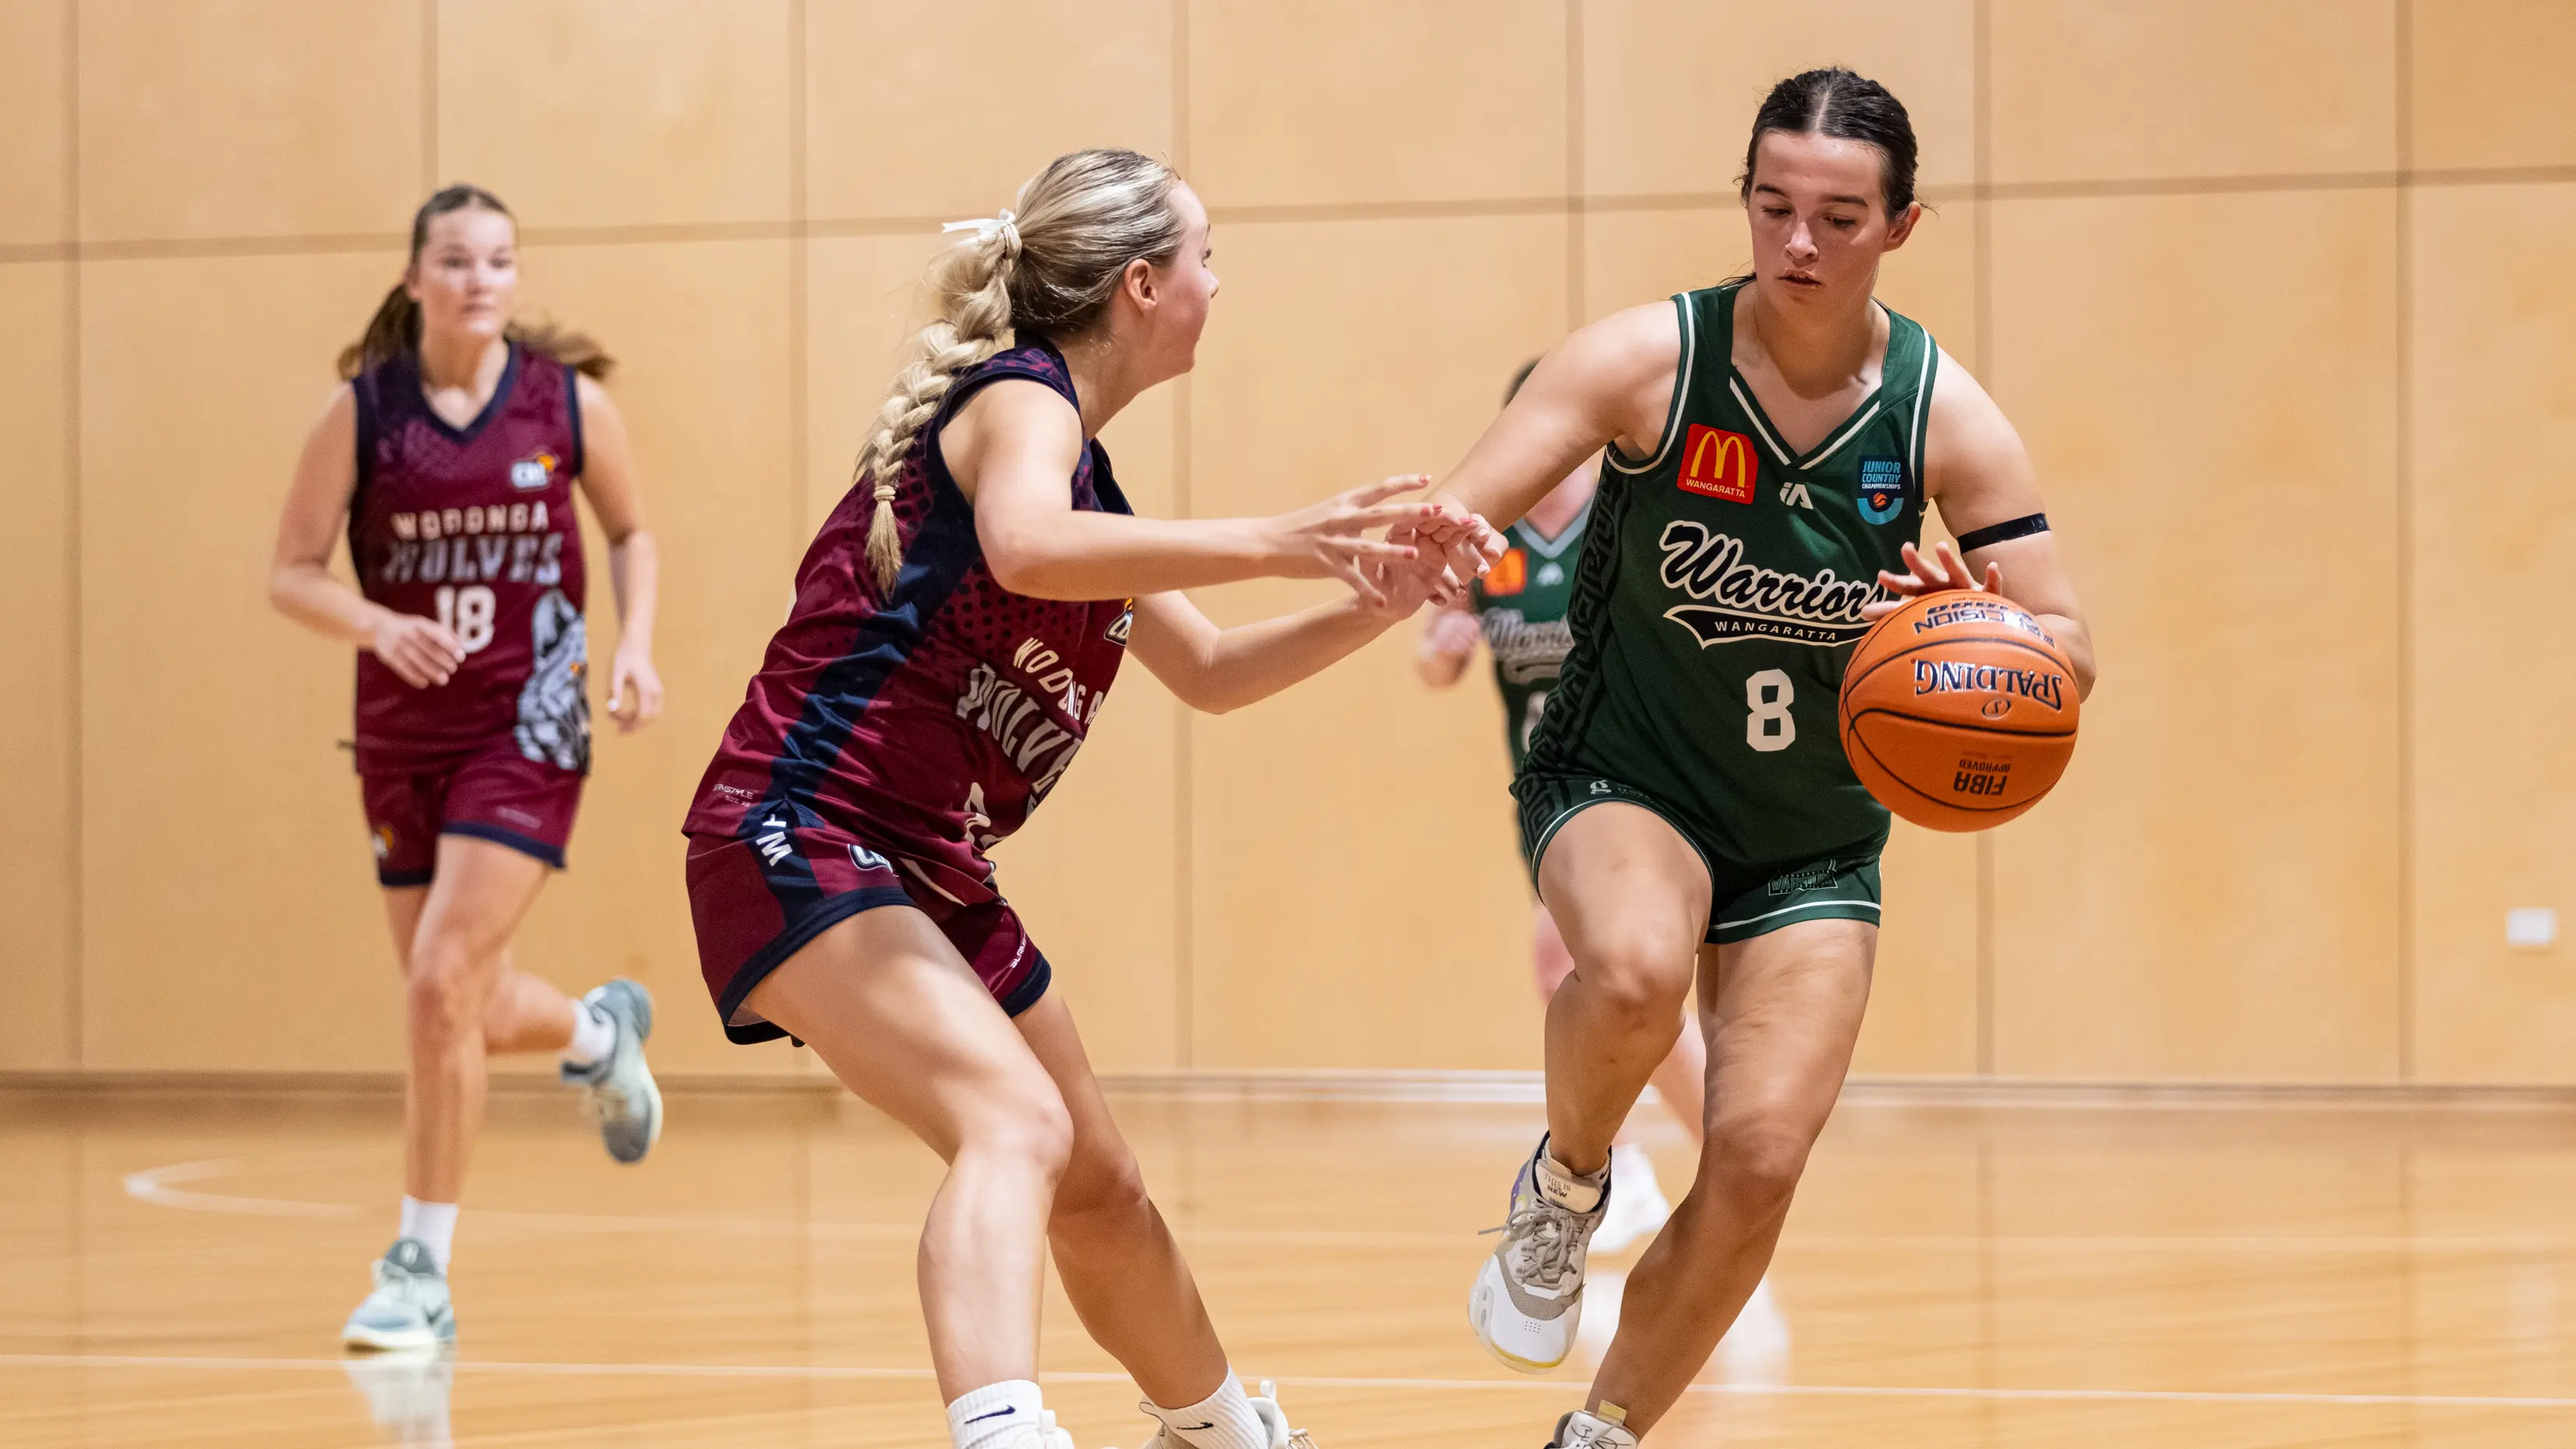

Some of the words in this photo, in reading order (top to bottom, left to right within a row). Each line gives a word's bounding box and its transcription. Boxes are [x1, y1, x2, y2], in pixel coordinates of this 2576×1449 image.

[1862, 460, 1901, 474] JUNIOR
[1862, 473, 1901, 483] COUNTRY
[1686, 478, 1746, 499] WANGARATTA
[391, 500, 549, 541] WODONGA
[381, 532, 564, 585] WOLVES
[434, 584, 497, 654] 18
[1714, 620, 1836, 641] WANGARATTA
[1013, 636, 1105, 725] WODNGA
[1914, 658, 2063, 711] SPALDING
[1746, 668, 1796, 753] 8
[956, 661, 1085, 819] WOLVE
[1953, 770, 2008, 795] FIBA
[1958, 758, 2011, 774] APPROVED
